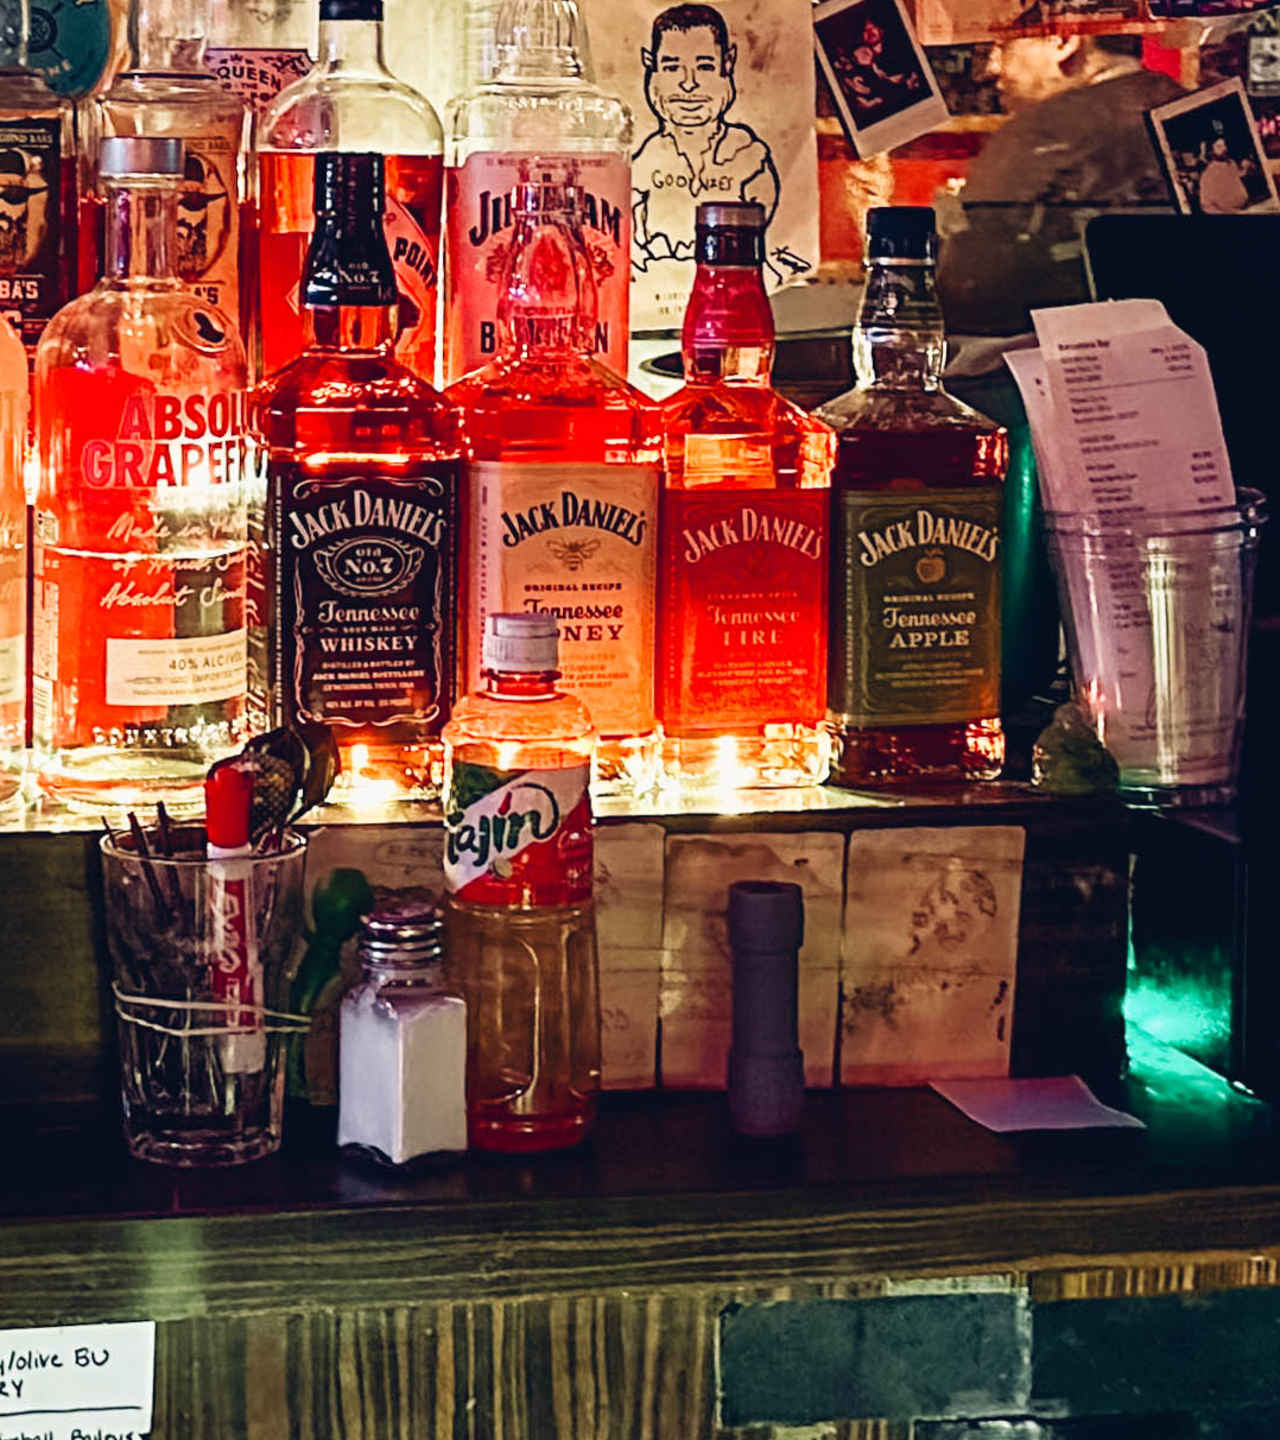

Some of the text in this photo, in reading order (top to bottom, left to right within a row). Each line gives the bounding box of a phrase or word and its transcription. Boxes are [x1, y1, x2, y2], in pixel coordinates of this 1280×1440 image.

[288, 489, 447, 550] JACK DANIEL'S
[501, 491, 648, 548] JACK DANIEL'S
[682, 508, 824, 563] JACK DANIEL'S
[857, 510, 999, 567] JACK DANIEL'S
[100, 580, 195, 609] Absolut
[318, 600, 419, 623] Tennessee
[523, 598, 623, 619] Tennessee
[706, 605, 799, 625] Tennessee
[882, 606, 977, 629] Tennessee
[320, 636, 418, 652] WHISKEY
[558, 625, 623, 641] NEY
[723, 630, 783, 646] FIRE
[889, 630, 970, 648] APPLE
